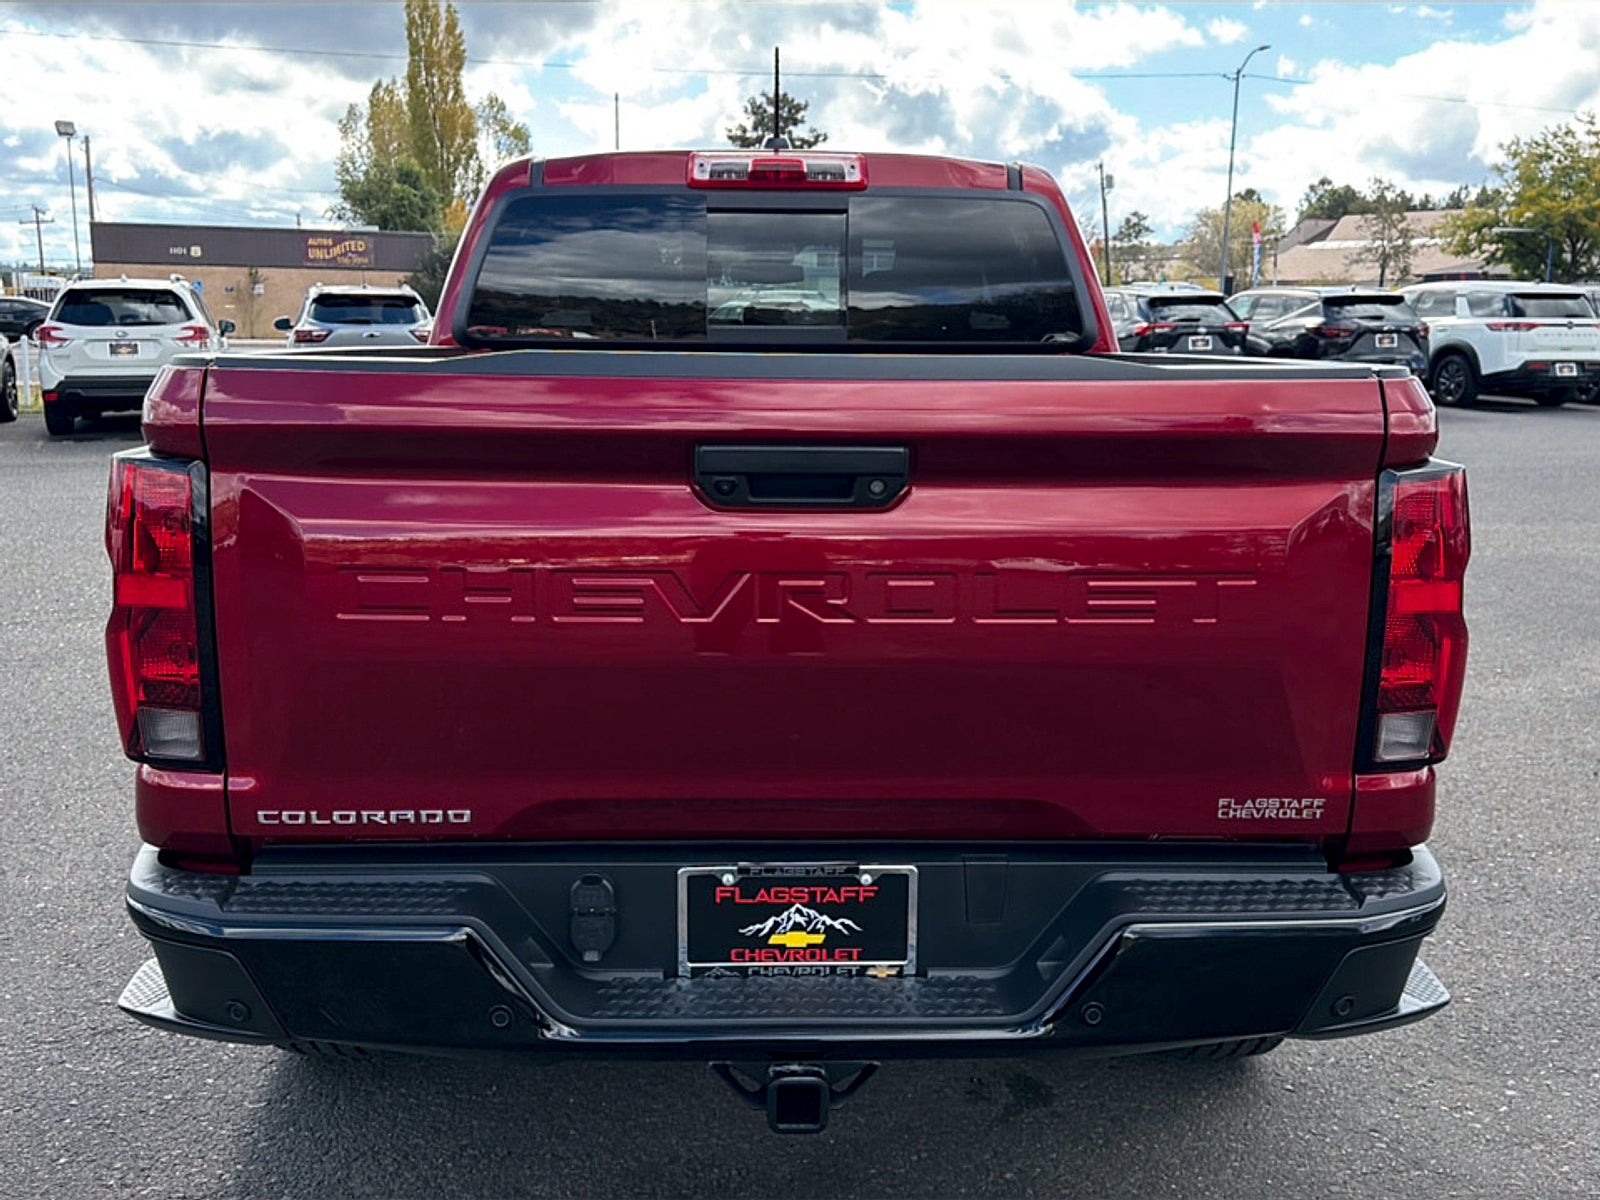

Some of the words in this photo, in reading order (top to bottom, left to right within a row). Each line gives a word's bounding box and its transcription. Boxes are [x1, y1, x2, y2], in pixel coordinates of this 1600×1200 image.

[308, 240, 367, 259] UNLIMITED
[335, 566, 1257, 623] CHEVROLET
[1218, 798, 1326, 808] FLAGSTAFF
[257, 809, 472, 825] COLORADO
[1217, 808, 1324, 819] CHEVROLET
[749, 866, 848, 877] FLAGSTAFF
[715, 886, 879, 904] FLAGSTAFF
[730, 948, 863, 962] CHEVROLET
